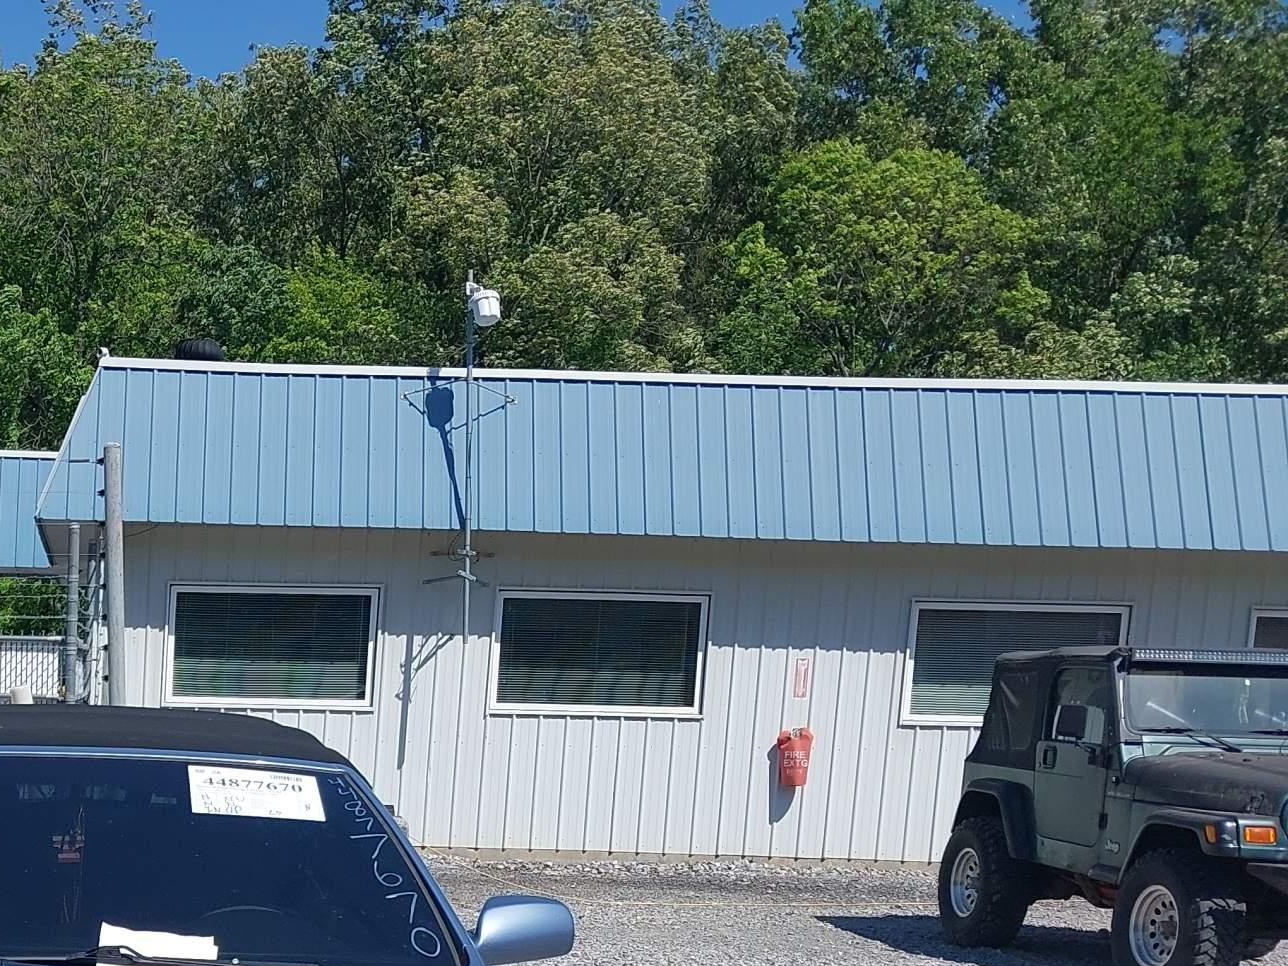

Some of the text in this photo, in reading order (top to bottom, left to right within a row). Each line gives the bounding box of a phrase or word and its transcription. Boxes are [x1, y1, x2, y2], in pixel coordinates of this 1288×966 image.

[784, 750, 806, 759] FIRE
[783, 759, 809, 767] EXTG
[202, 776, 303, 793] 44877670
